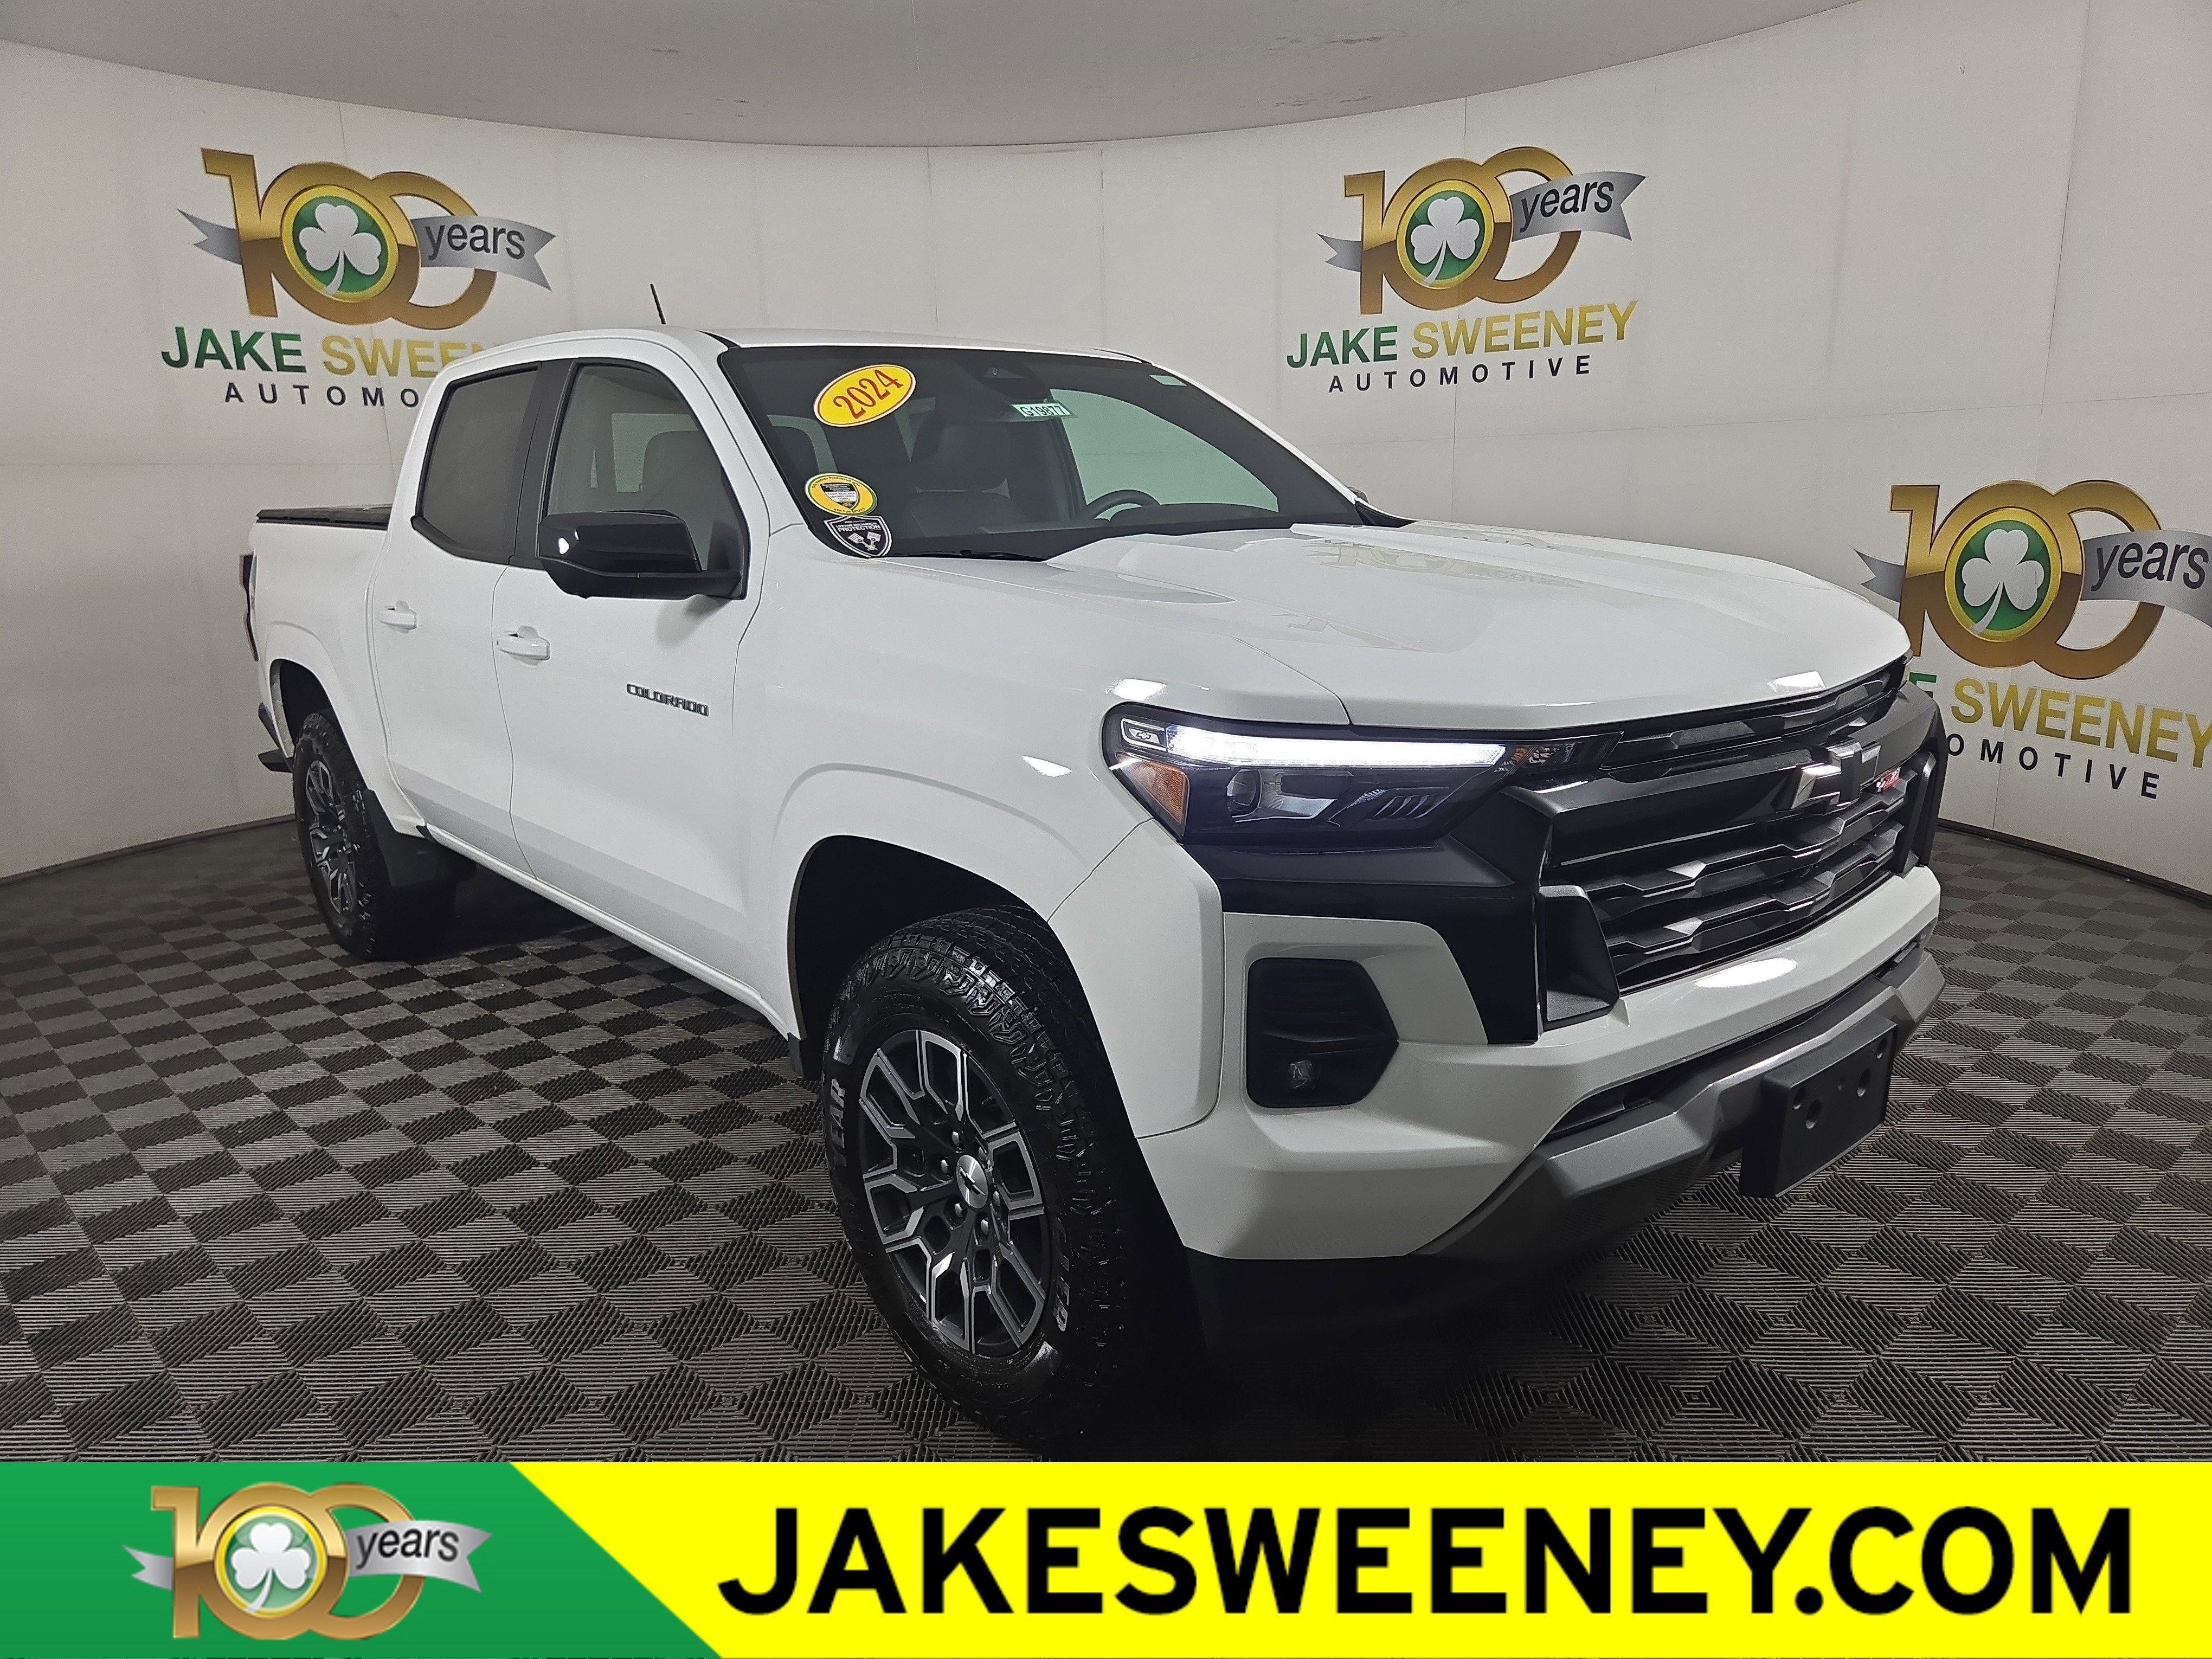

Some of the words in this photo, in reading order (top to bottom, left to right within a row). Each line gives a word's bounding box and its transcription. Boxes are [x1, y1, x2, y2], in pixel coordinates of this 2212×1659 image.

[201, 147, 497, 330] 100
[425, 222, 526, 260] years
[1344, 146, 1582, 315] 100
[1519, 181, 1615, 233] years
[161, 326, 307, 374] JAKE
[322, 335, 500, 378] SWEE
[1287, 325, 1398, 369] JAKE
[1412, 300, 1638, 359] SWEENEY
[224, 382, 419, 408] AUTOMO
[833, 369, 904, 419] 2024
[1328, 355, 1591, 394] AUTOMOTIVE
[1020, 406, 1066, 416] G19877
[1890, 479, 2165, 680] 100
[2091, 542, 2209, 591] years
[627, 684, 709, 717] COLORADO
[1949, 734, 2159, 800] OMOTIVE
